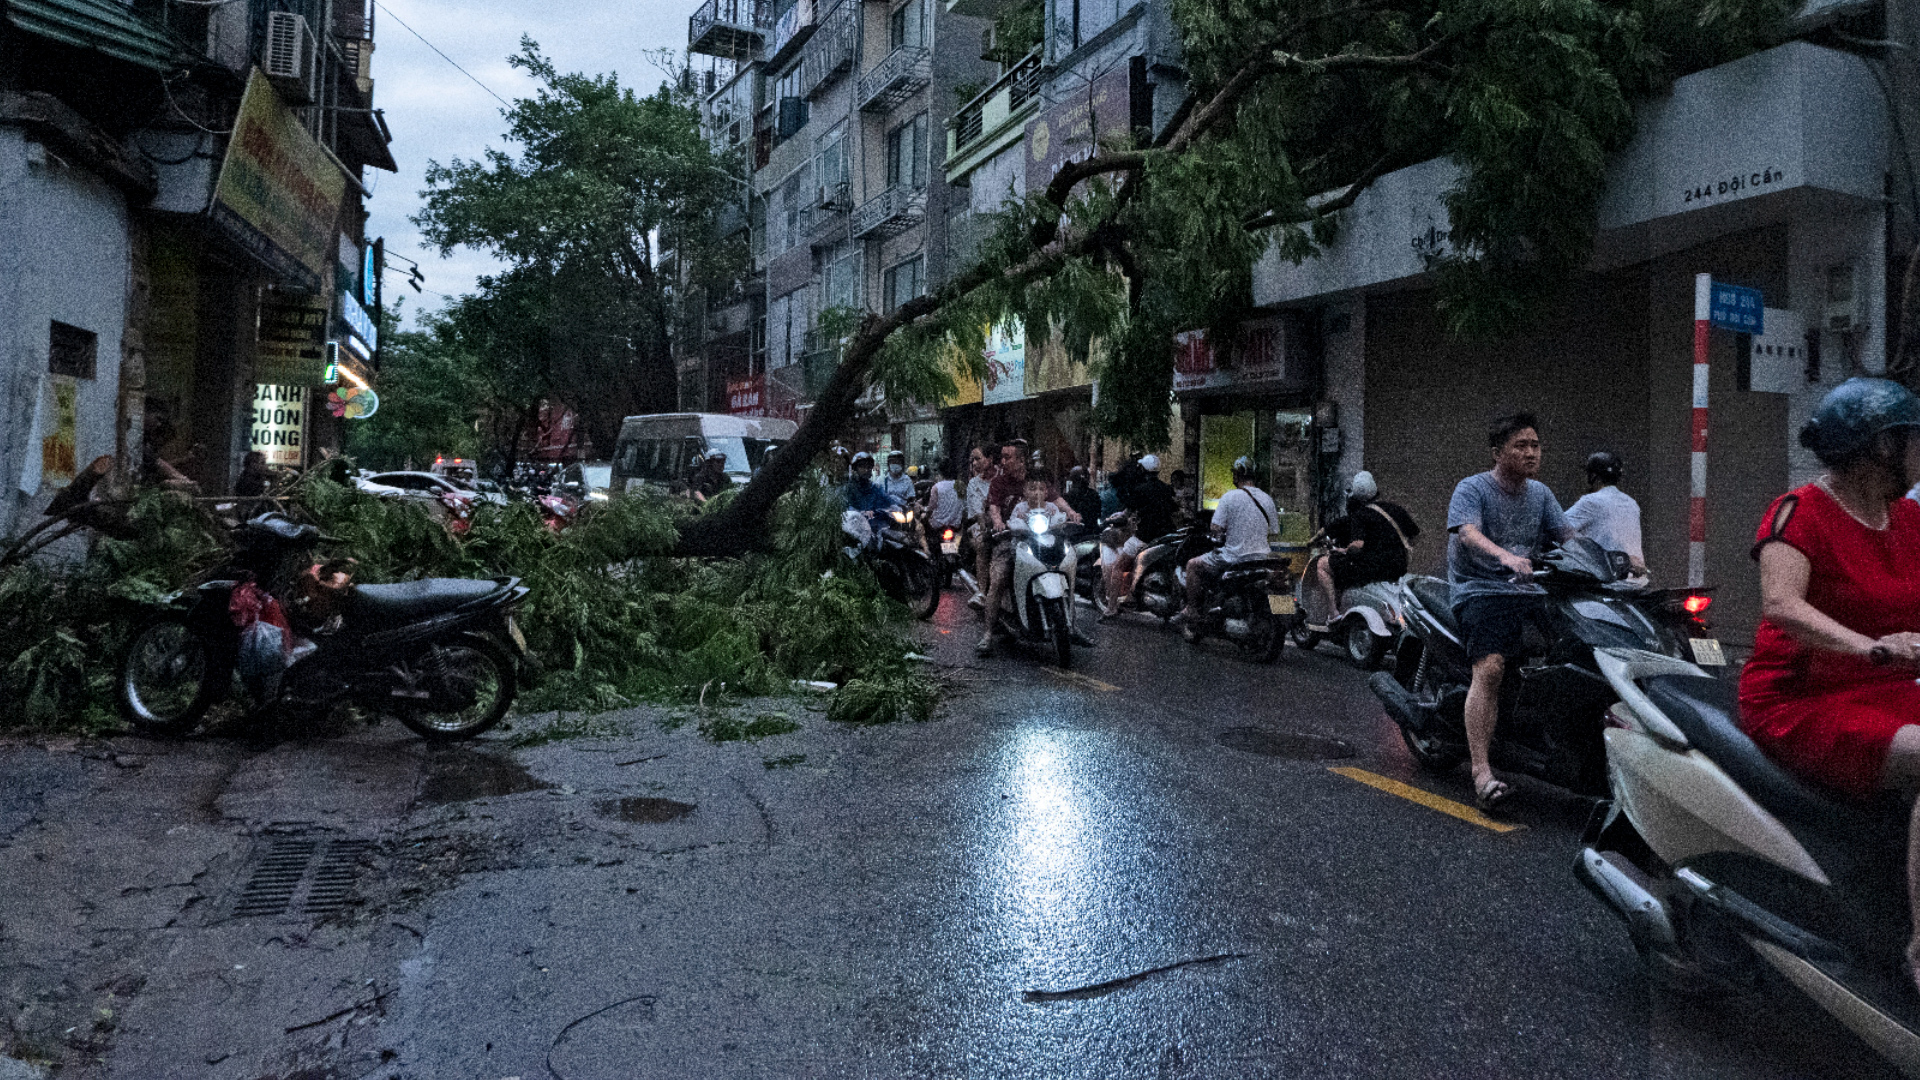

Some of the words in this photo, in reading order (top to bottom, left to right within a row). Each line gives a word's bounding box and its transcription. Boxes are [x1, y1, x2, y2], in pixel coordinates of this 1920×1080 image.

[1684, 185, 1712, 202] 244
[1717, 175, 1746, 195] Đội
[251, 426, 301, 446] NÓNG
